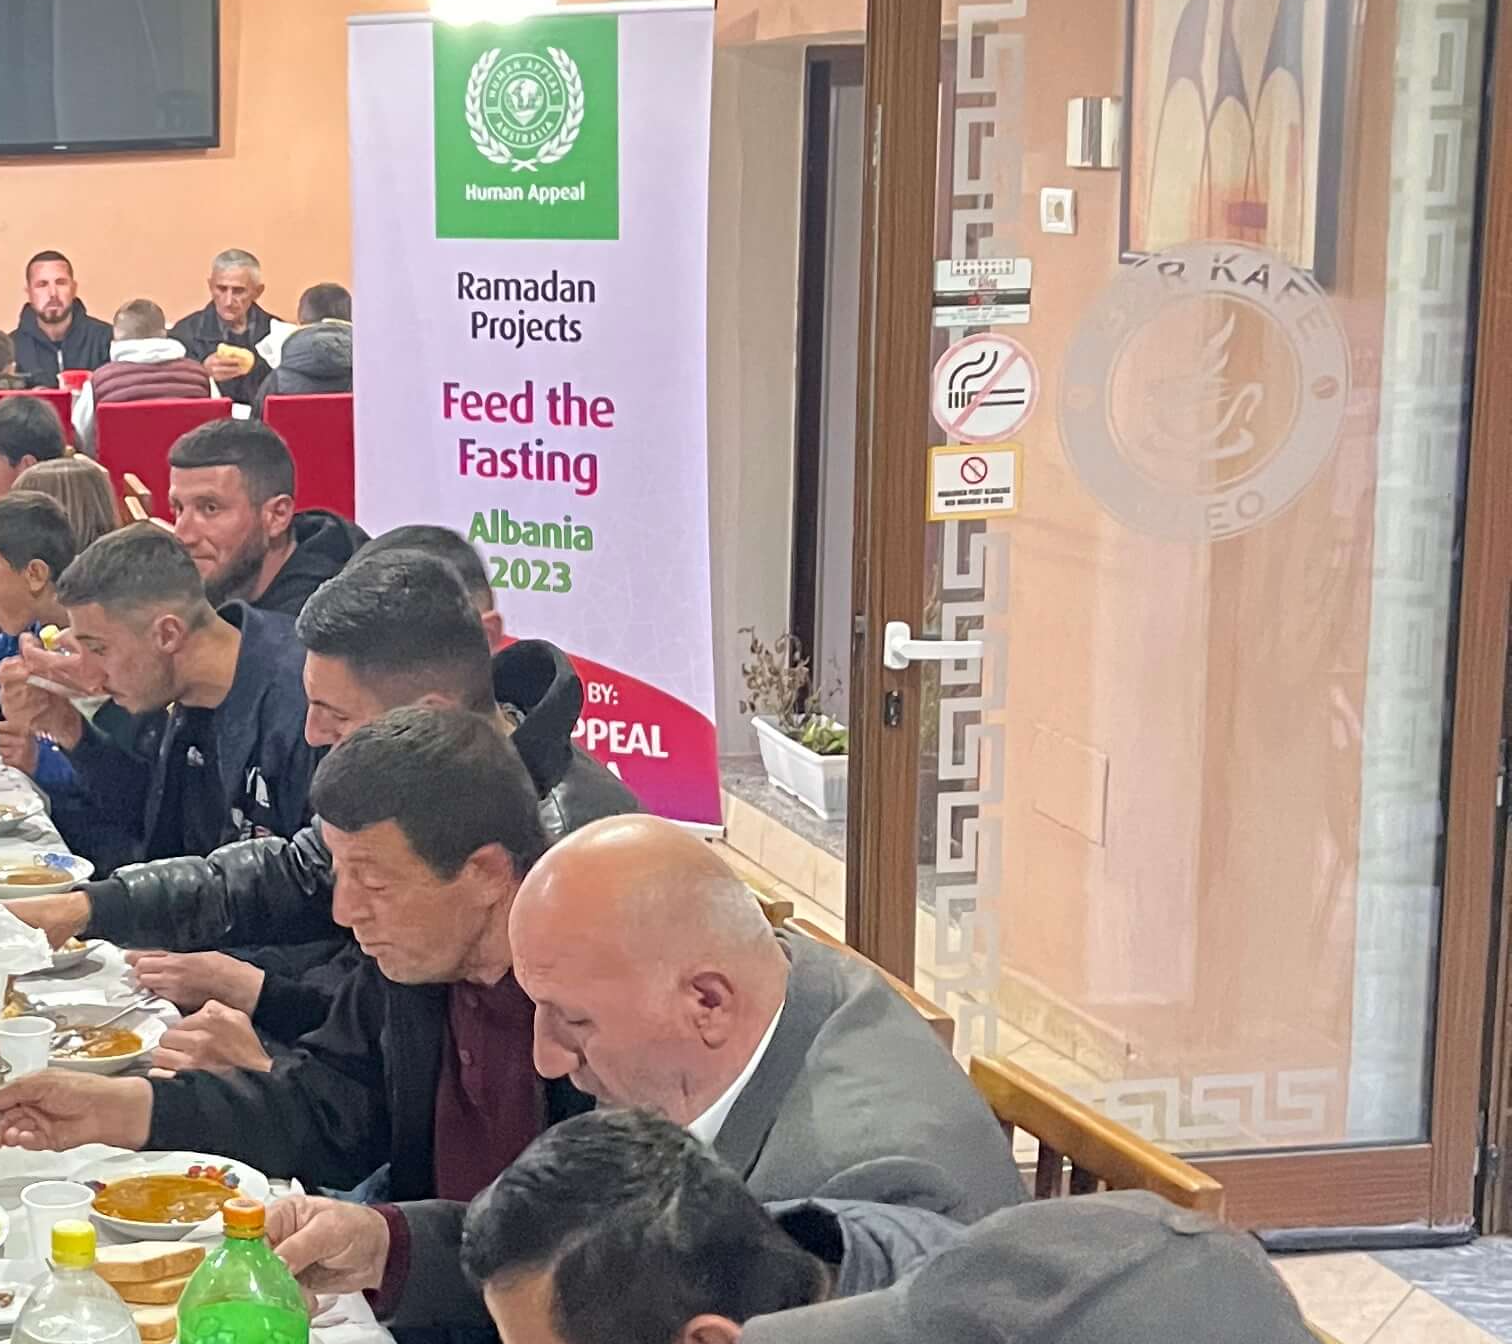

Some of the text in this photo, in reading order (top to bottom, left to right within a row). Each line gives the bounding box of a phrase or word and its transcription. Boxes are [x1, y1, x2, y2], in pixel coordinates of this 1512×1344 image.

[489, 60, 521, 98] HUMAN
[495, 120, 554, 144] AUSTRALIA
[465, 180, 585, 206] Human Appeal
[457, 269, 596, 303] Ramadan
[471, 309, 583, 349] Projects
[443, 380, 616, 428] Feed the
[459, 438, 598, 496] Fasting
[467, 508, 594, 551] Albania
[489, 556, 573, 594] 2023
[588, 681, 620, 705] BY:
[570, 717, 670, 759] PPEAL
